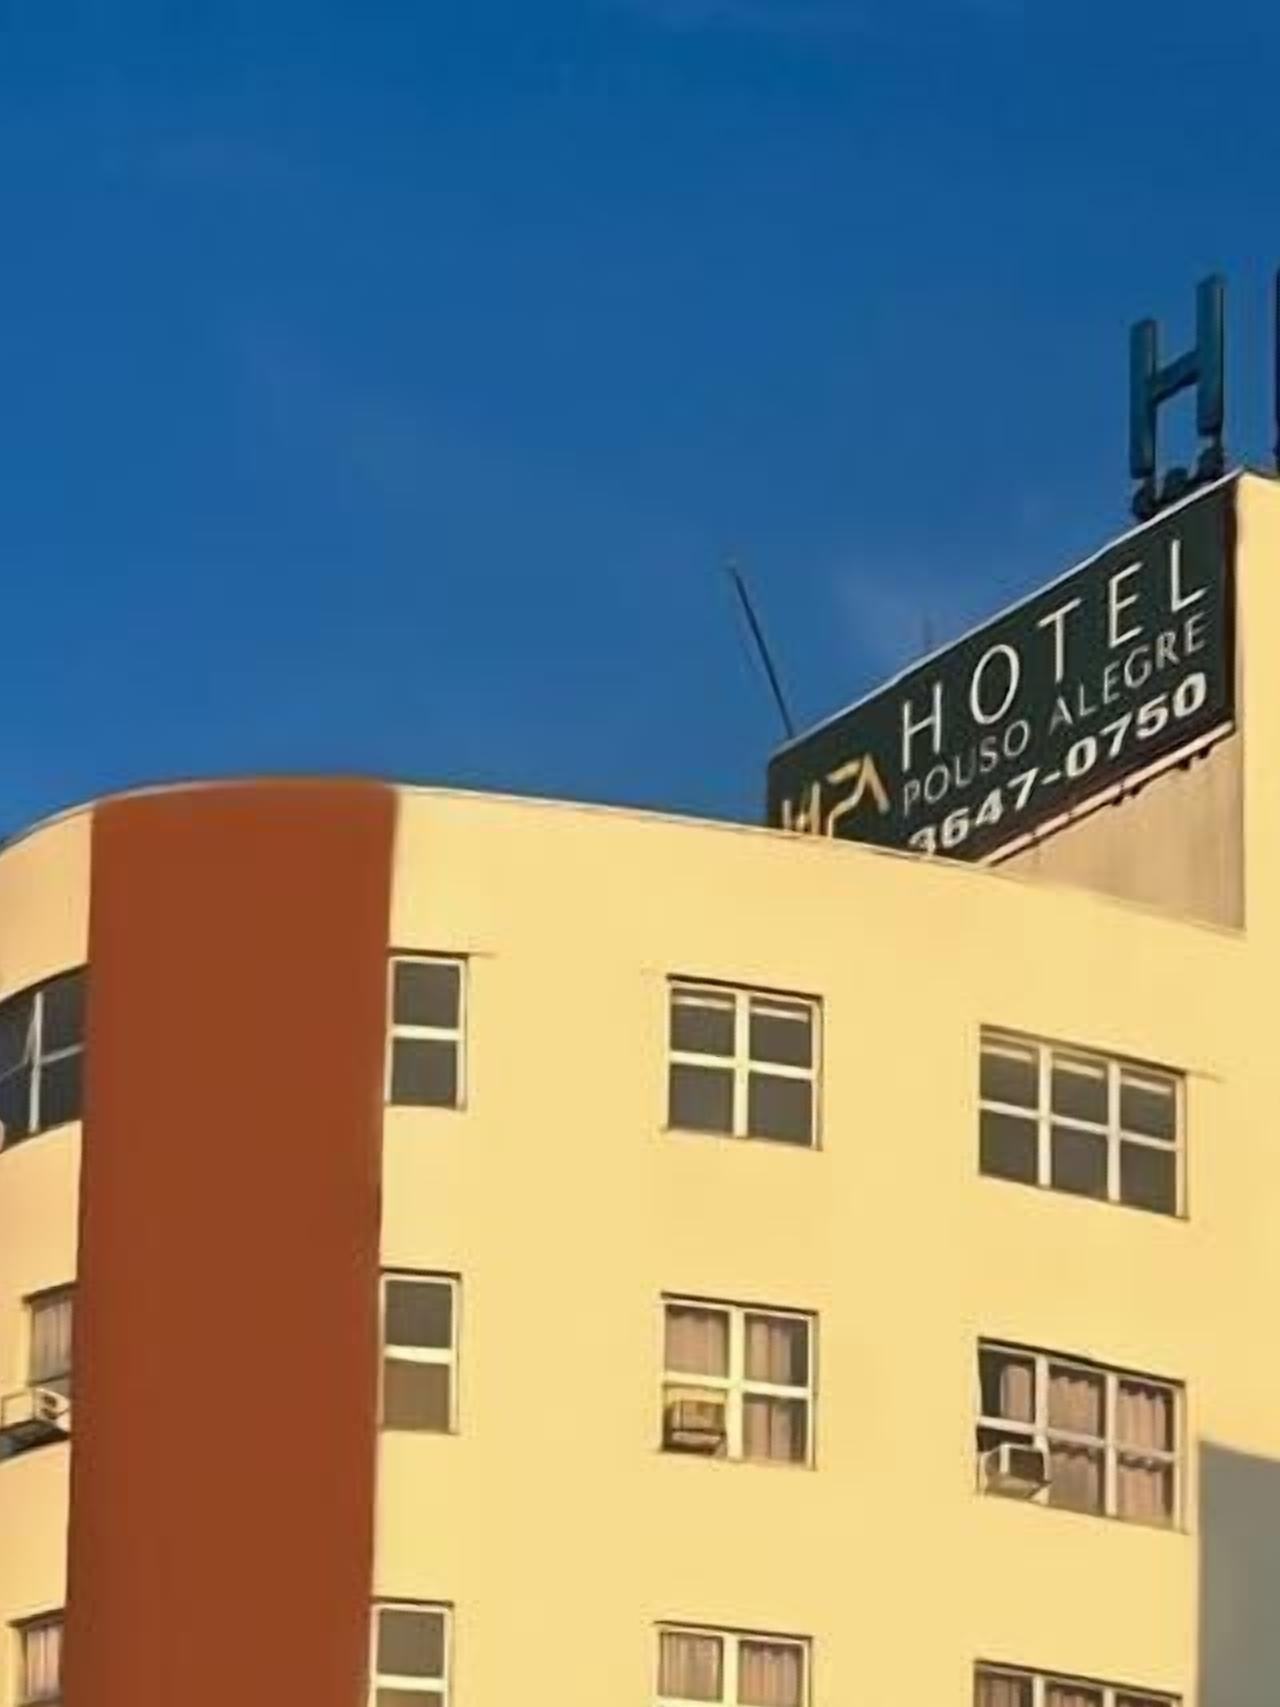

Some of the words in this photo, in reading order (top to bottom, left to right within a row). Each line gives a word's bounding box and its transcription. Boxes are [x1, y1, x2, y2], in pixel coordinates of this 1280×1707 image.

[901, 538, 1209, 772] HOTEL
[903, 718, 1030, 817] POUSO
[1048, 611, 1210, 733] ALEGRE
